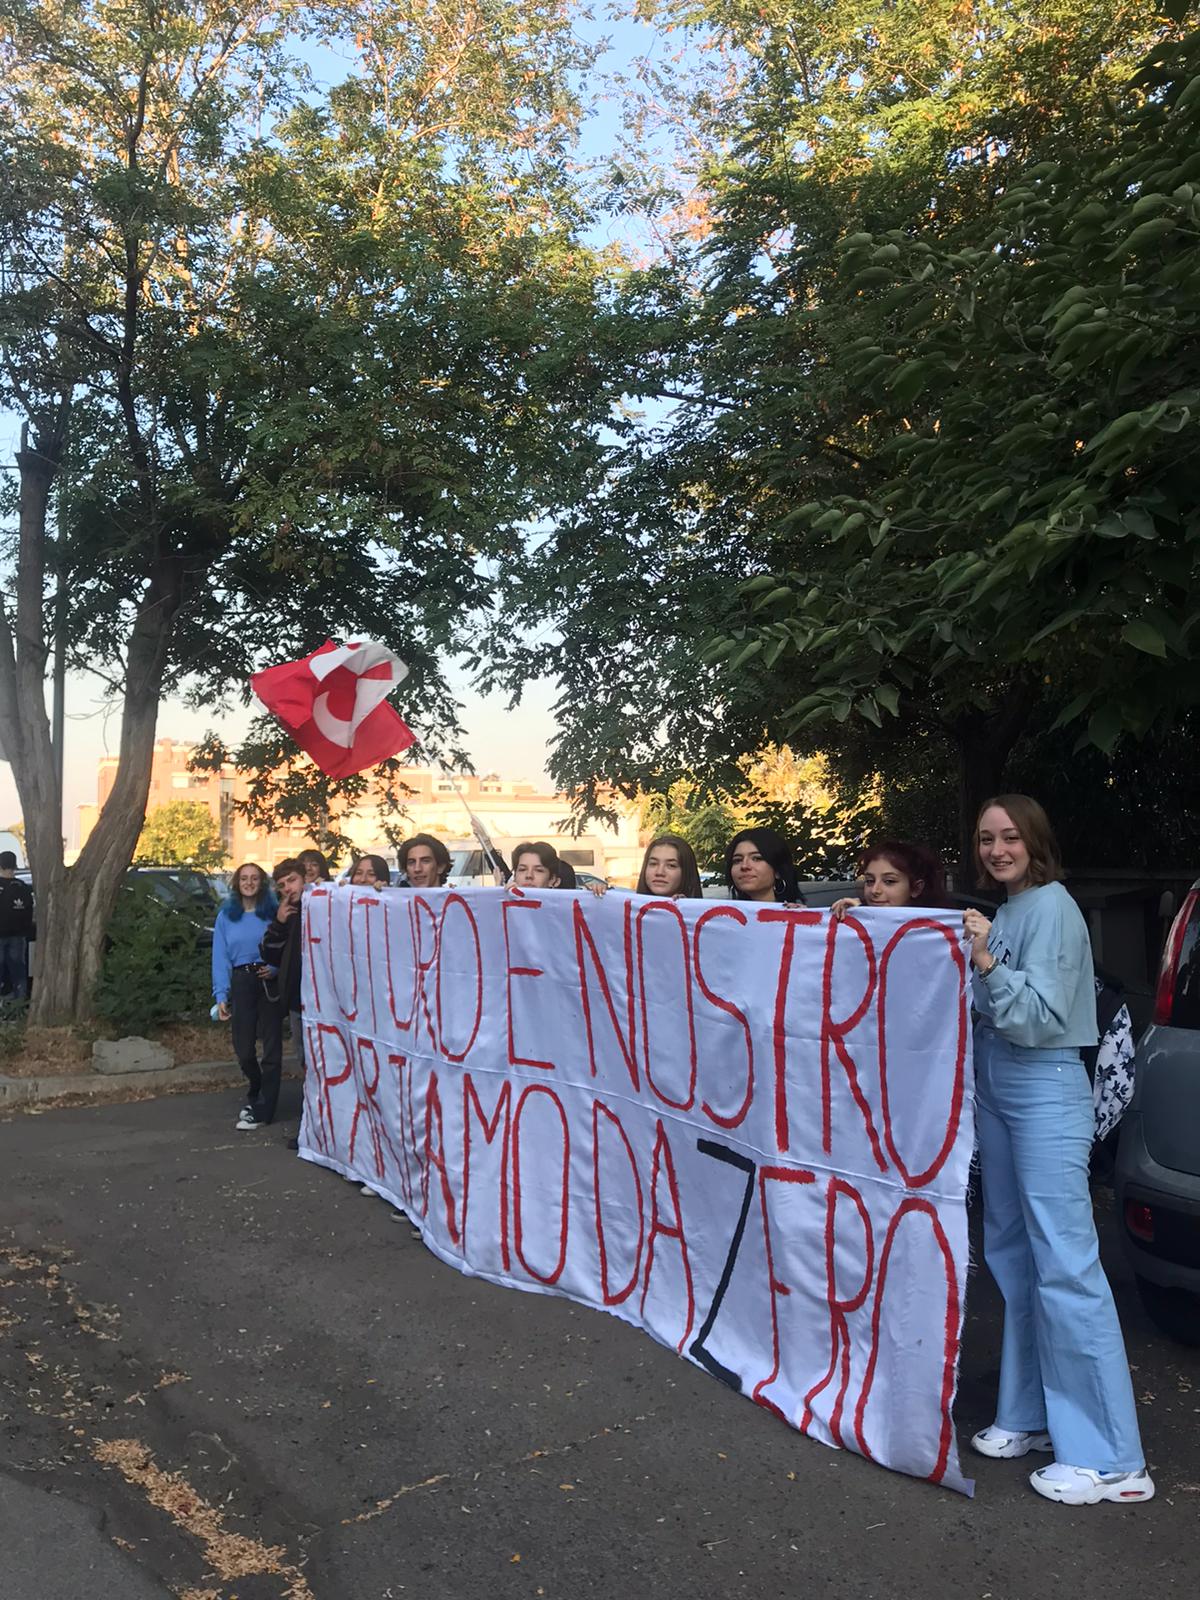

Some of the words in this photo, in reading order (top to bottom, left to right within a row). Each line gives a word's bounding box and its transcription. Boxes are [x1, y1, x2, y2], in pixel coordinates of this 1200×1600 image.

[307, 889, 483, 1062] FUTURO
[572, 899, 967, 1188] NOSTRO
[592, 1098, 695, 1354] DA
[689, 1138, 960, 1484] ZERO
